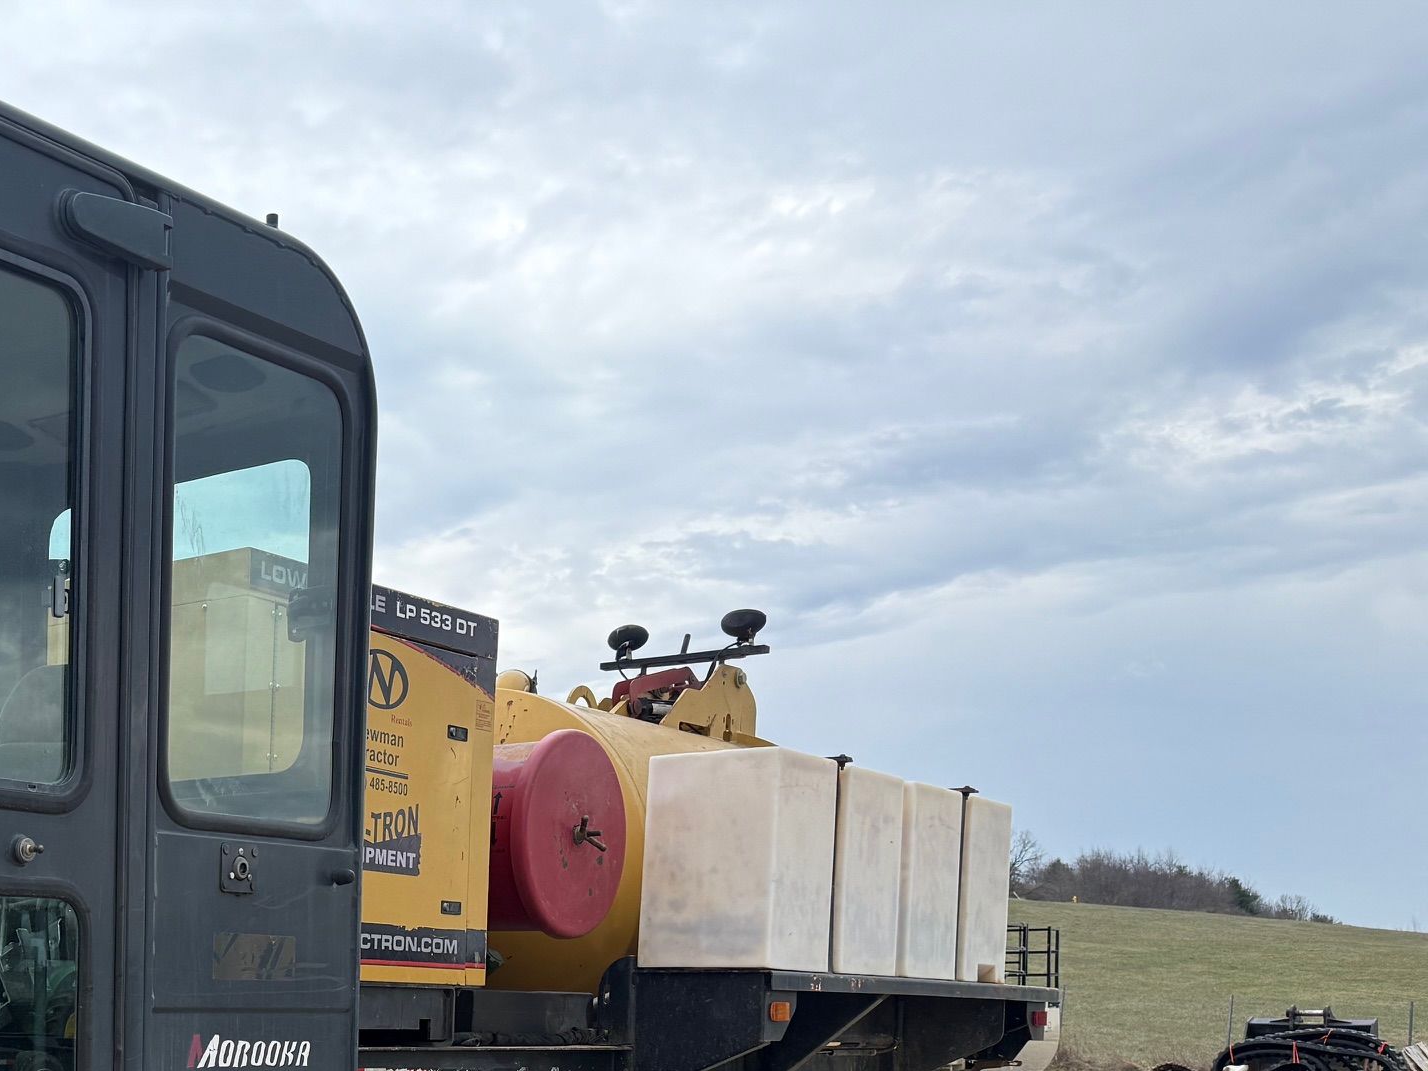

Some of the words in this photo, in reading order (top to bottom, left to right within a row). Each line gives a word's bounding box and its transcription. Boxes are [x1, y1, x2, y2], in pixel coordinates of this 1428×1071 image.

[261, 560, 308, 589] LOW
[396, 601, 416, 619] LP
[420, 609, 452, 631] 533
[456, 618, 477, 637] DT
[391, 714, 413, 728] Rentals
[187, 1033, 311, 1069] MOROOKA
